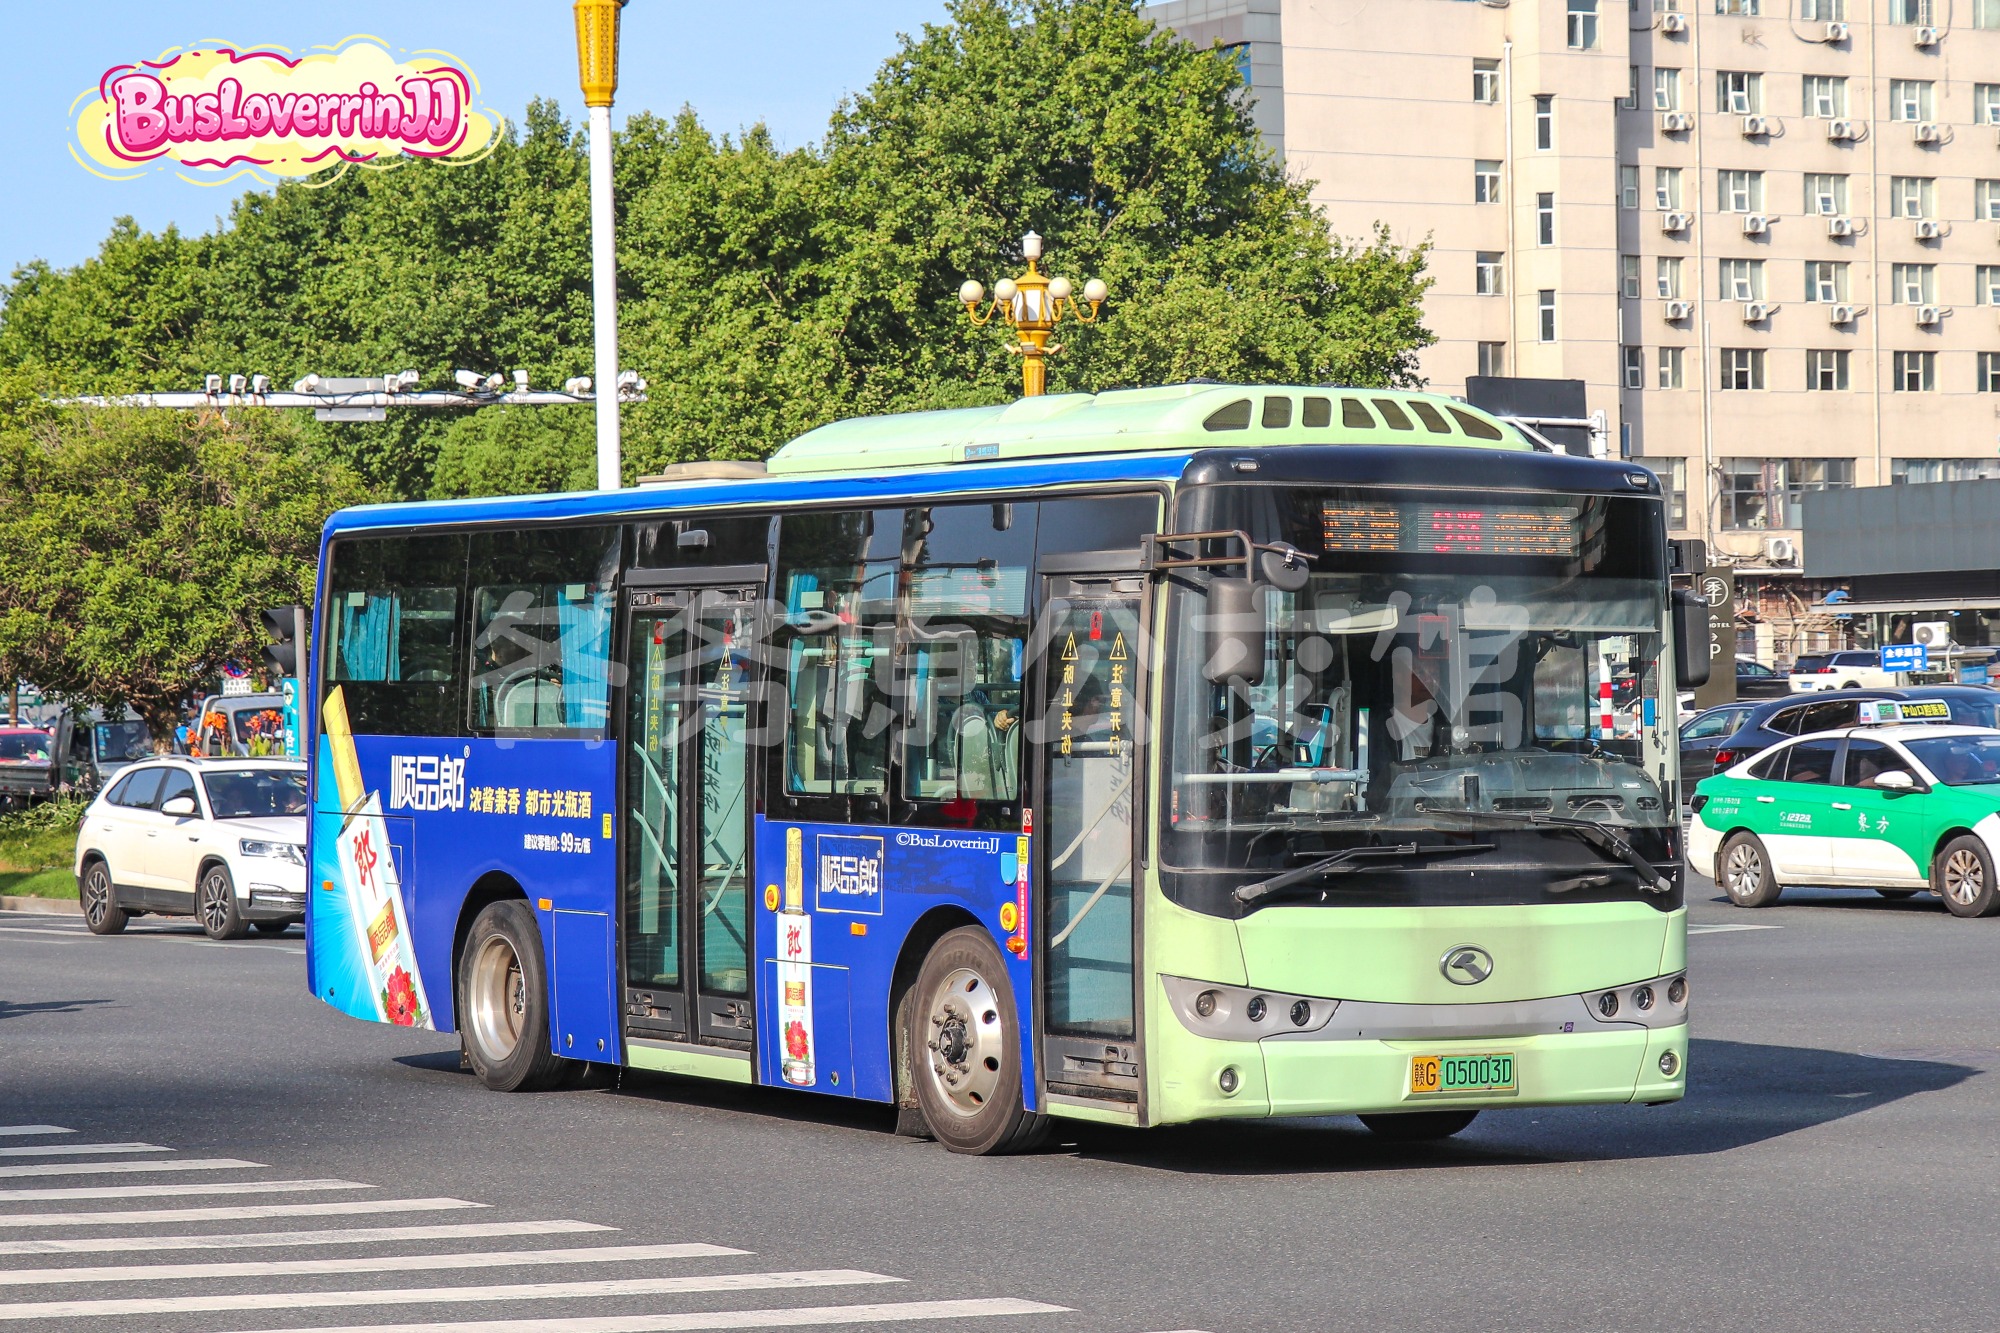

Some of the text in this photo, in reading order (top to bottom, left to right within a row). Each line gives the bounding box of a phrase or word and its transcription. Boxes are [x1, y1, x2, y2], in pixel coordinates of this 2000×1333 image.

[1705, 581, 1723, 604] 季
[1709, 643, 1721, 660] P
[1885, 647, 1923, 658] 全季酒店
[469, 787, 592, 819] 浓酱兼香 都市光瓶酒
